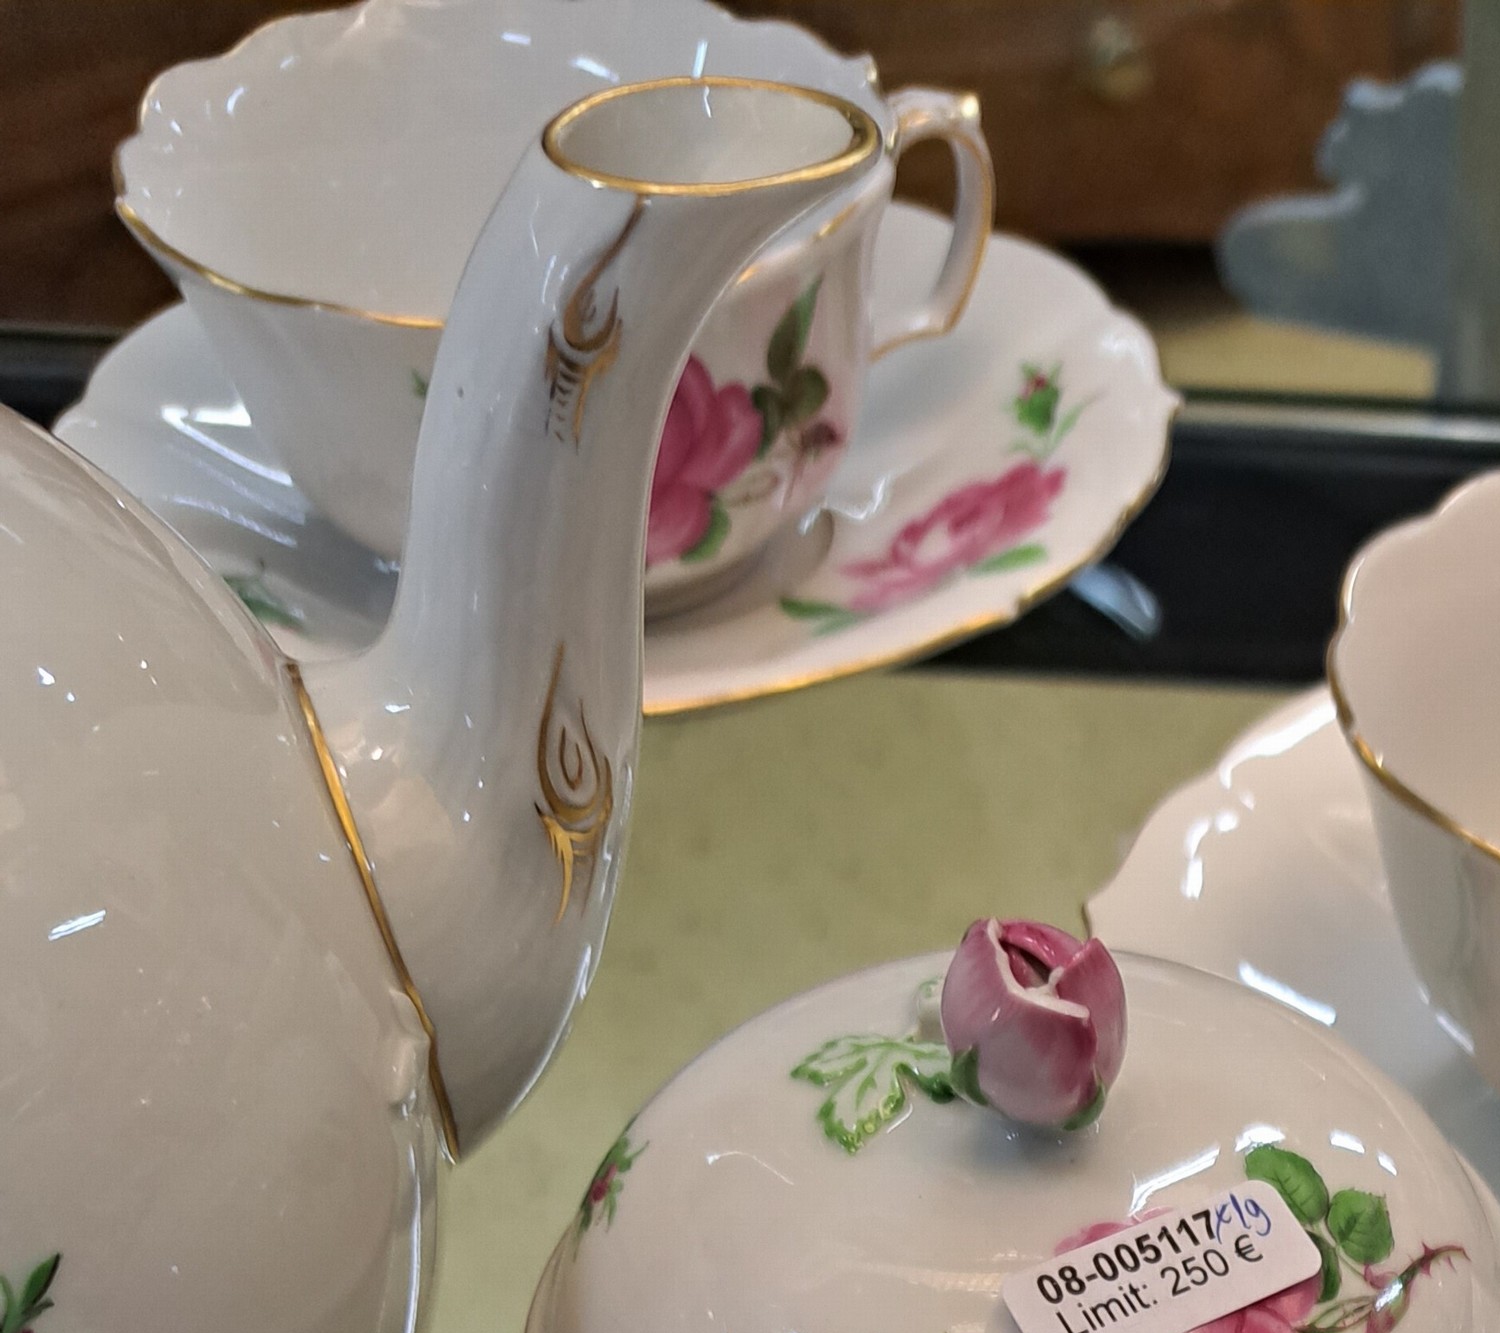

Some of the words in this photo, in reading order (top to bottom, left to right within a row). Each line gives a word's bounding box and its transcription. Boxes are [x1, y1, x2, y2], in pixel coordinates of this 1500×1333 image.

[1036, 1208, 1217, 1305] 08-005117
[1160, 1248, 1230, 1297] 250
[1233, 1233, 1264, 1263] €
